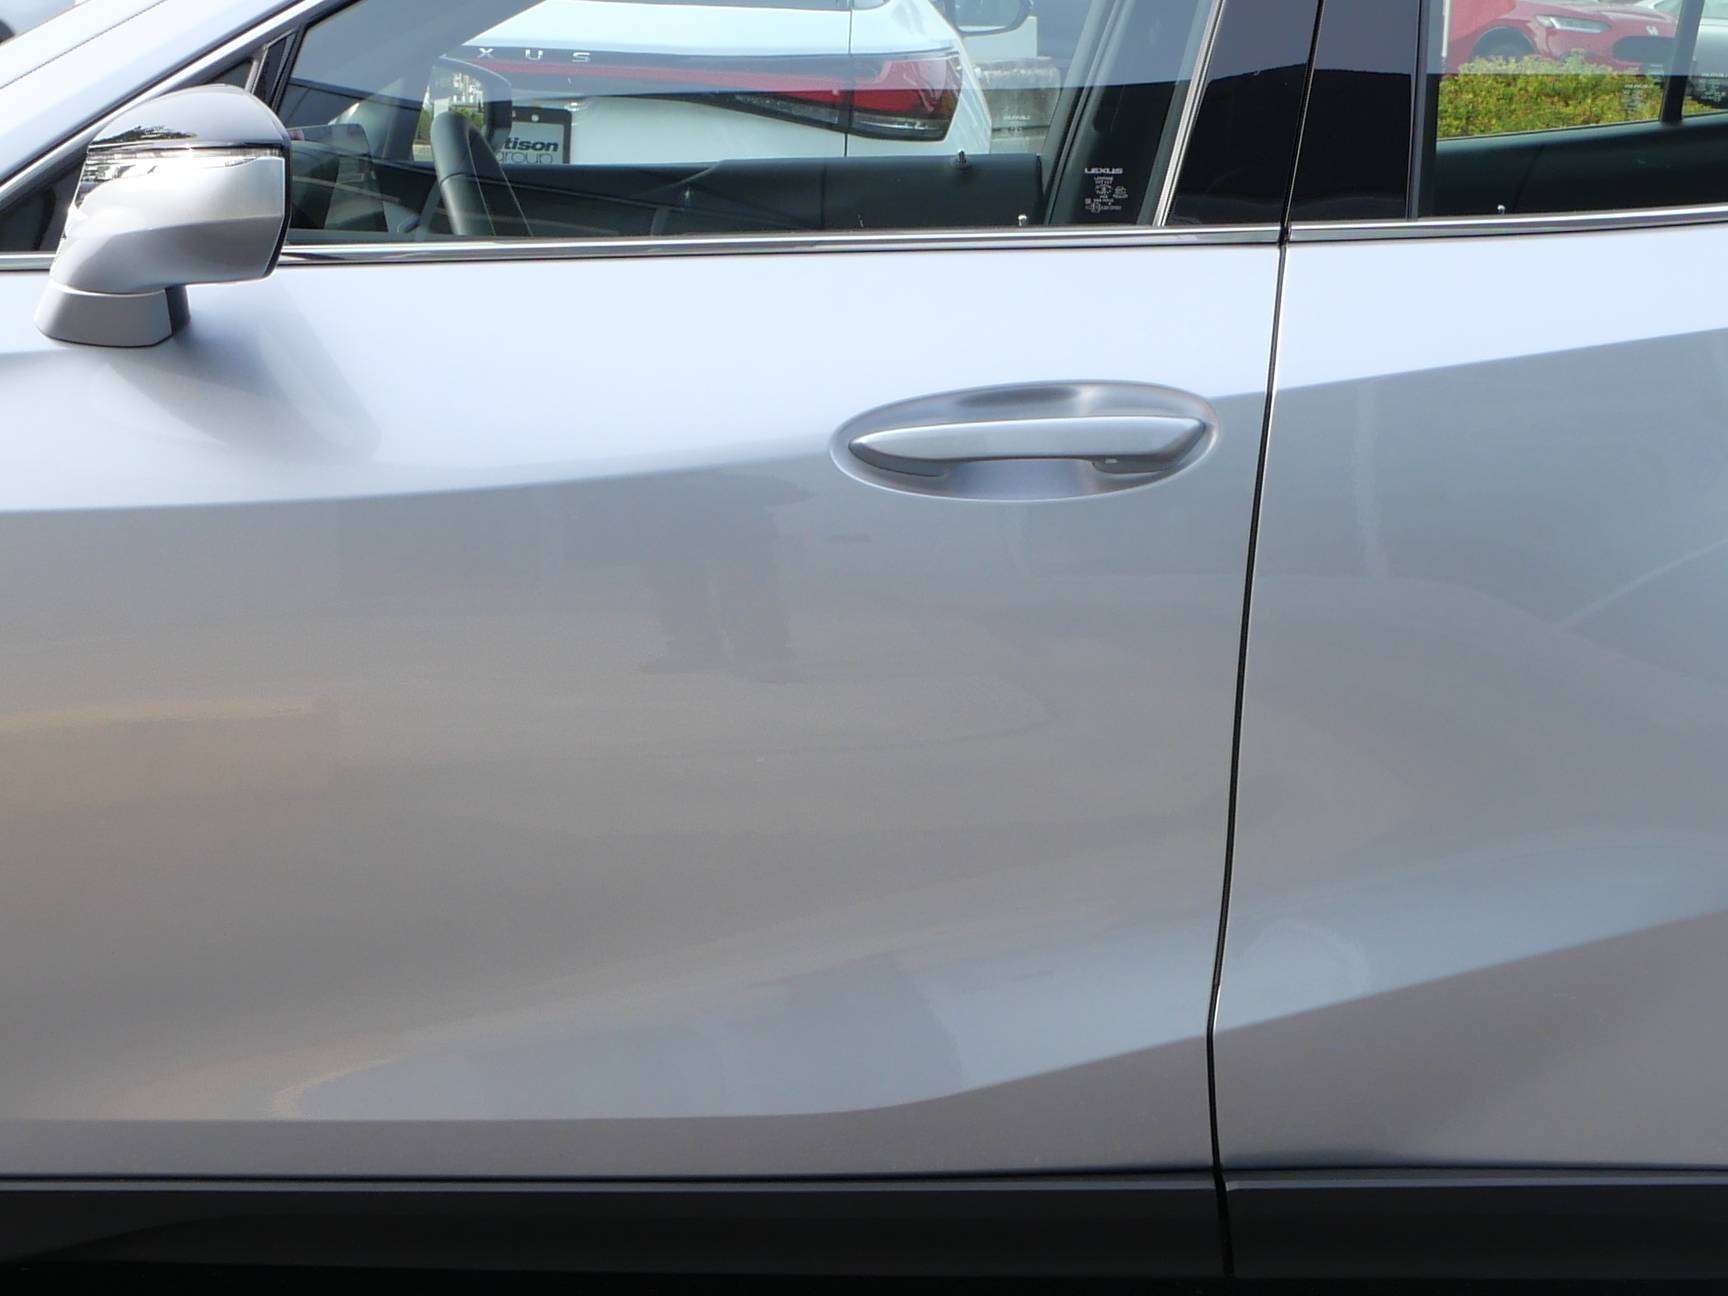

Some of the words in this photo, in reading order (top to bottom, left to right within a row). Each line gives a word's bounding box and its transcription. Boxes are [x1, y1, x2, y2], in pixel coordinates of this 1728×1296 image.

[479, 47, 591, 63] XUS
[504, 137, 559, 152] tison
[1084, 167, 1124, 175] LEXUS
